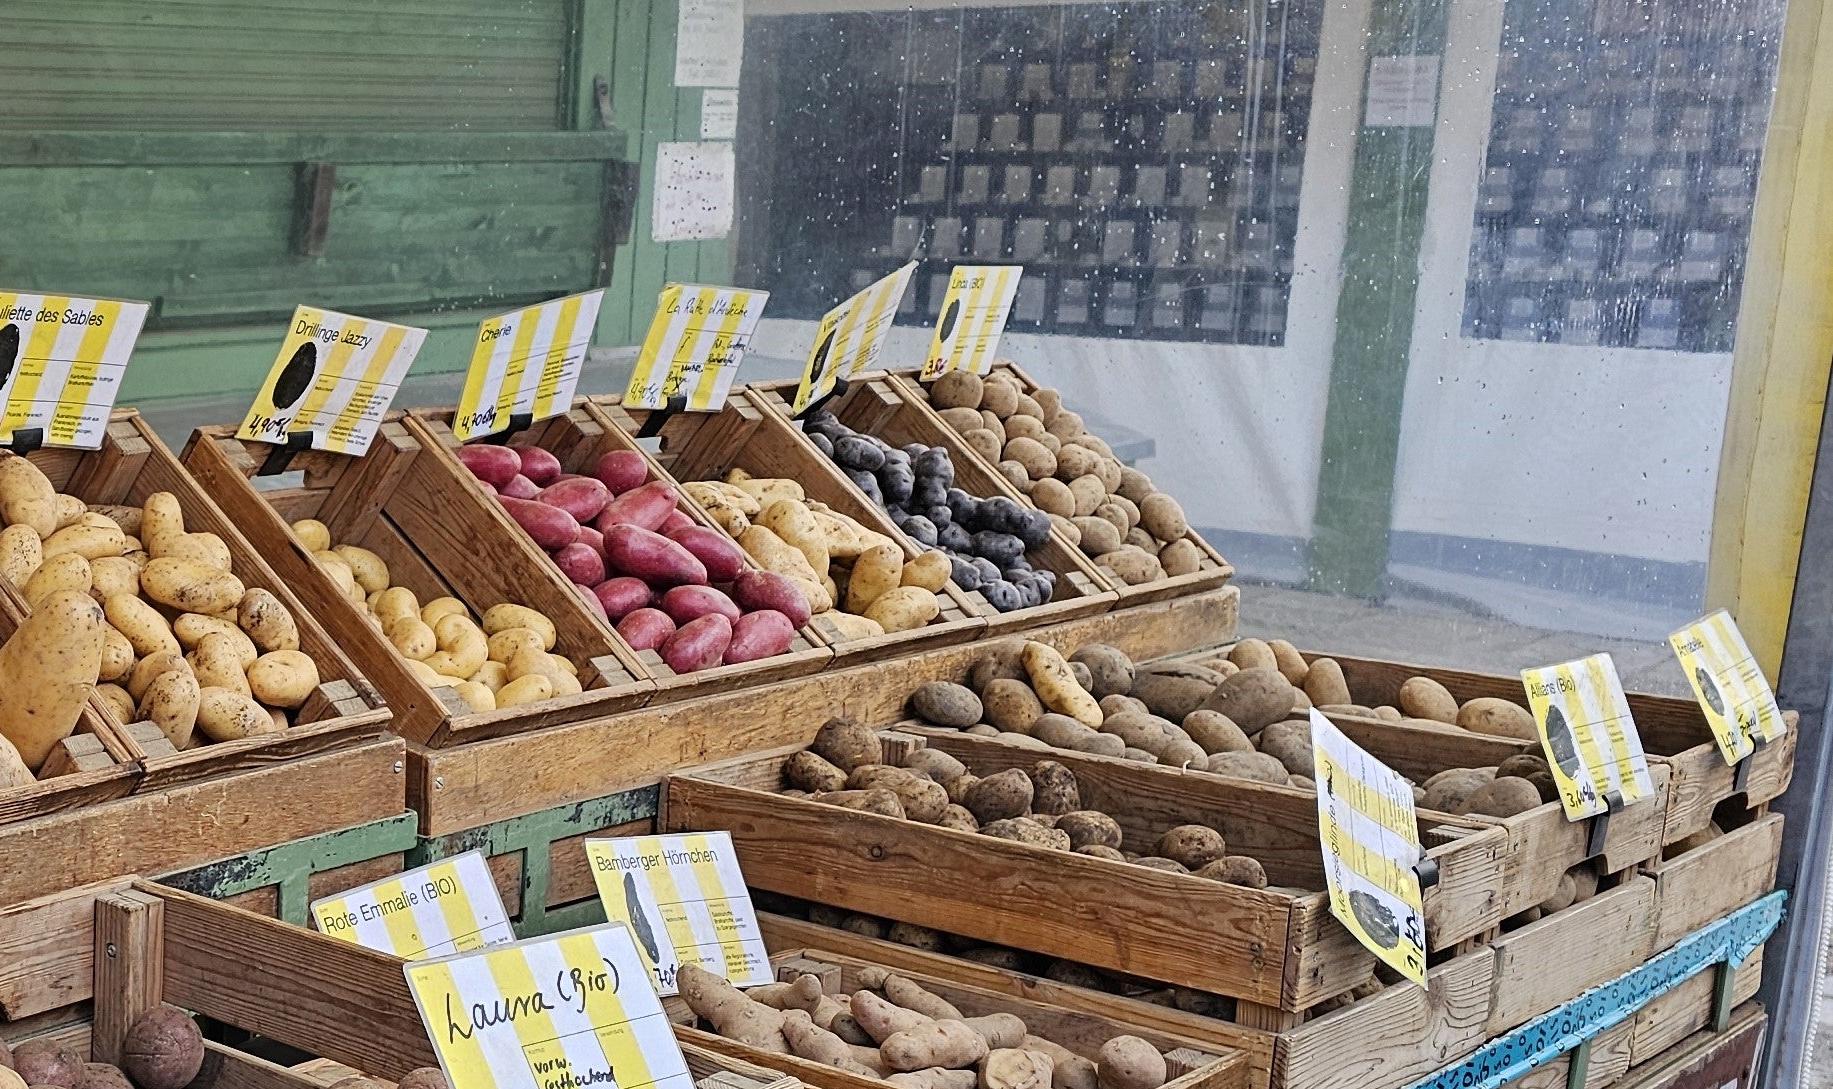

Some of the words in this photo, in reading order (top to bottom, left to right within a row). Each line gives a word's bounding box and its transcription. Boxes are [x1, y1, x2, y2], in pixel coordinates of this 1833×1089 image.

[34, 307, 58, 323] des
[61, 308, 105, 327] Sables
[295, 319, 340, 343] Drillinge
[340, 329, 373, 350] Jazzy
[595, 851, 661, 872] Bamberger
[661, 847, 719, 865] Hörnchen
[323, 910, 359, 935] Rote
[359, 890, 419, 922] Emmalie
[420, 875, 458, 904] (BIO)
[446, 991, 556, 1045] Laura
[556, 956, 621, 1014] (Bio)
[533, 1057, 573, 1075] vorw.
